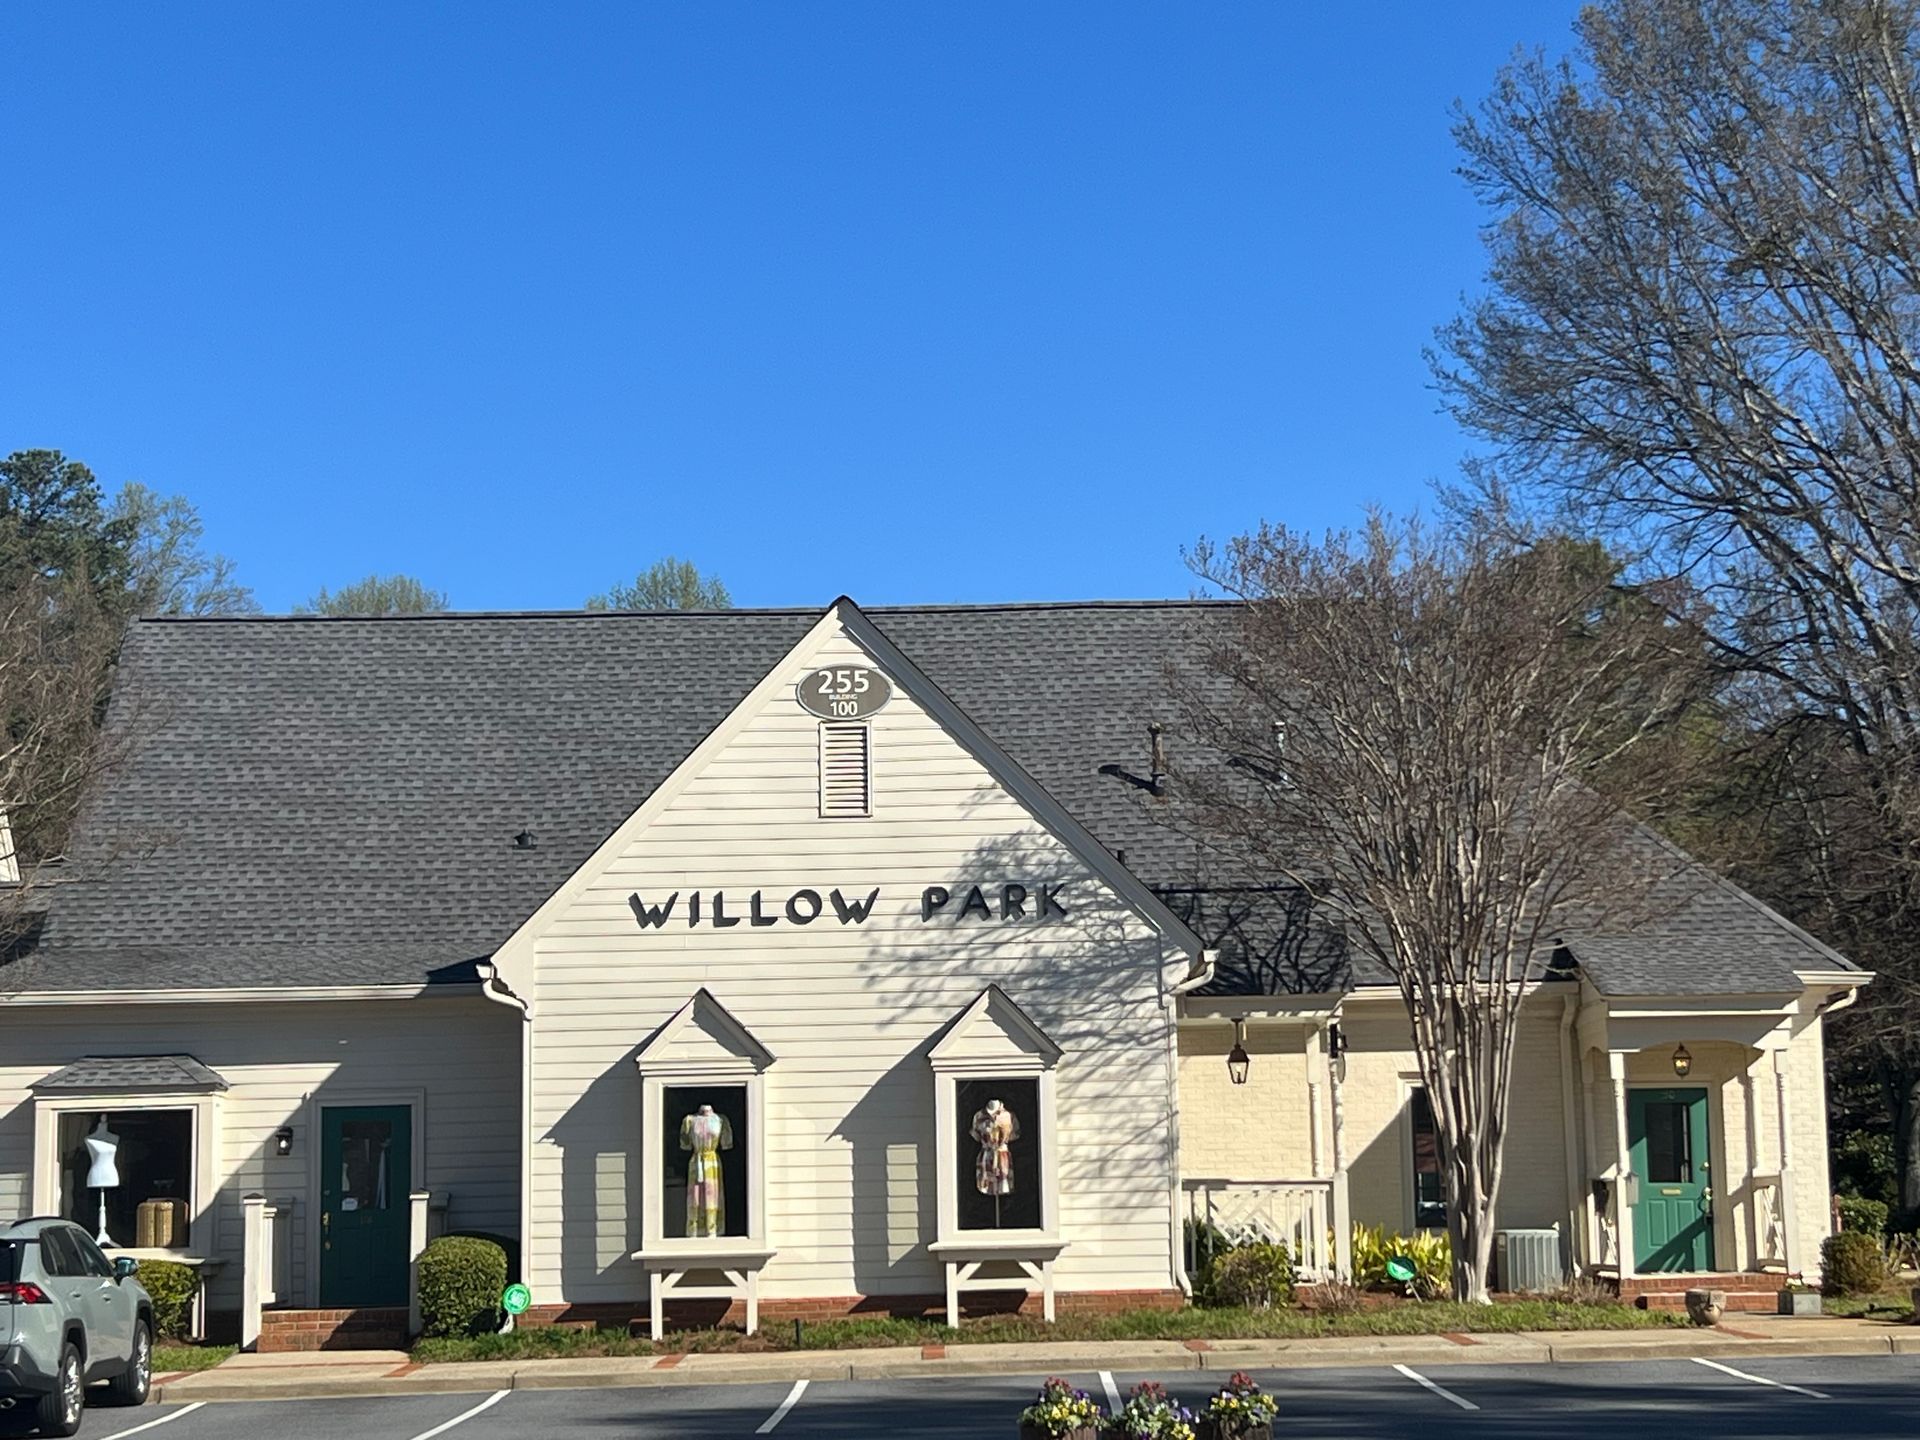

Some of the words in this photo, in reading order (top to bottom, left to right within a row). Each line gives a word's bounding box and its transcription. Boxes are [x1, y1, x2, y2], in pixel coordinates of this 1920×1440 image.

[818, 670, 870, 694] 255
[830, 701, 858, 716] 100
[628, 887, 881, 929] WILLOW
[920, 882, 1069, 923] PARK
